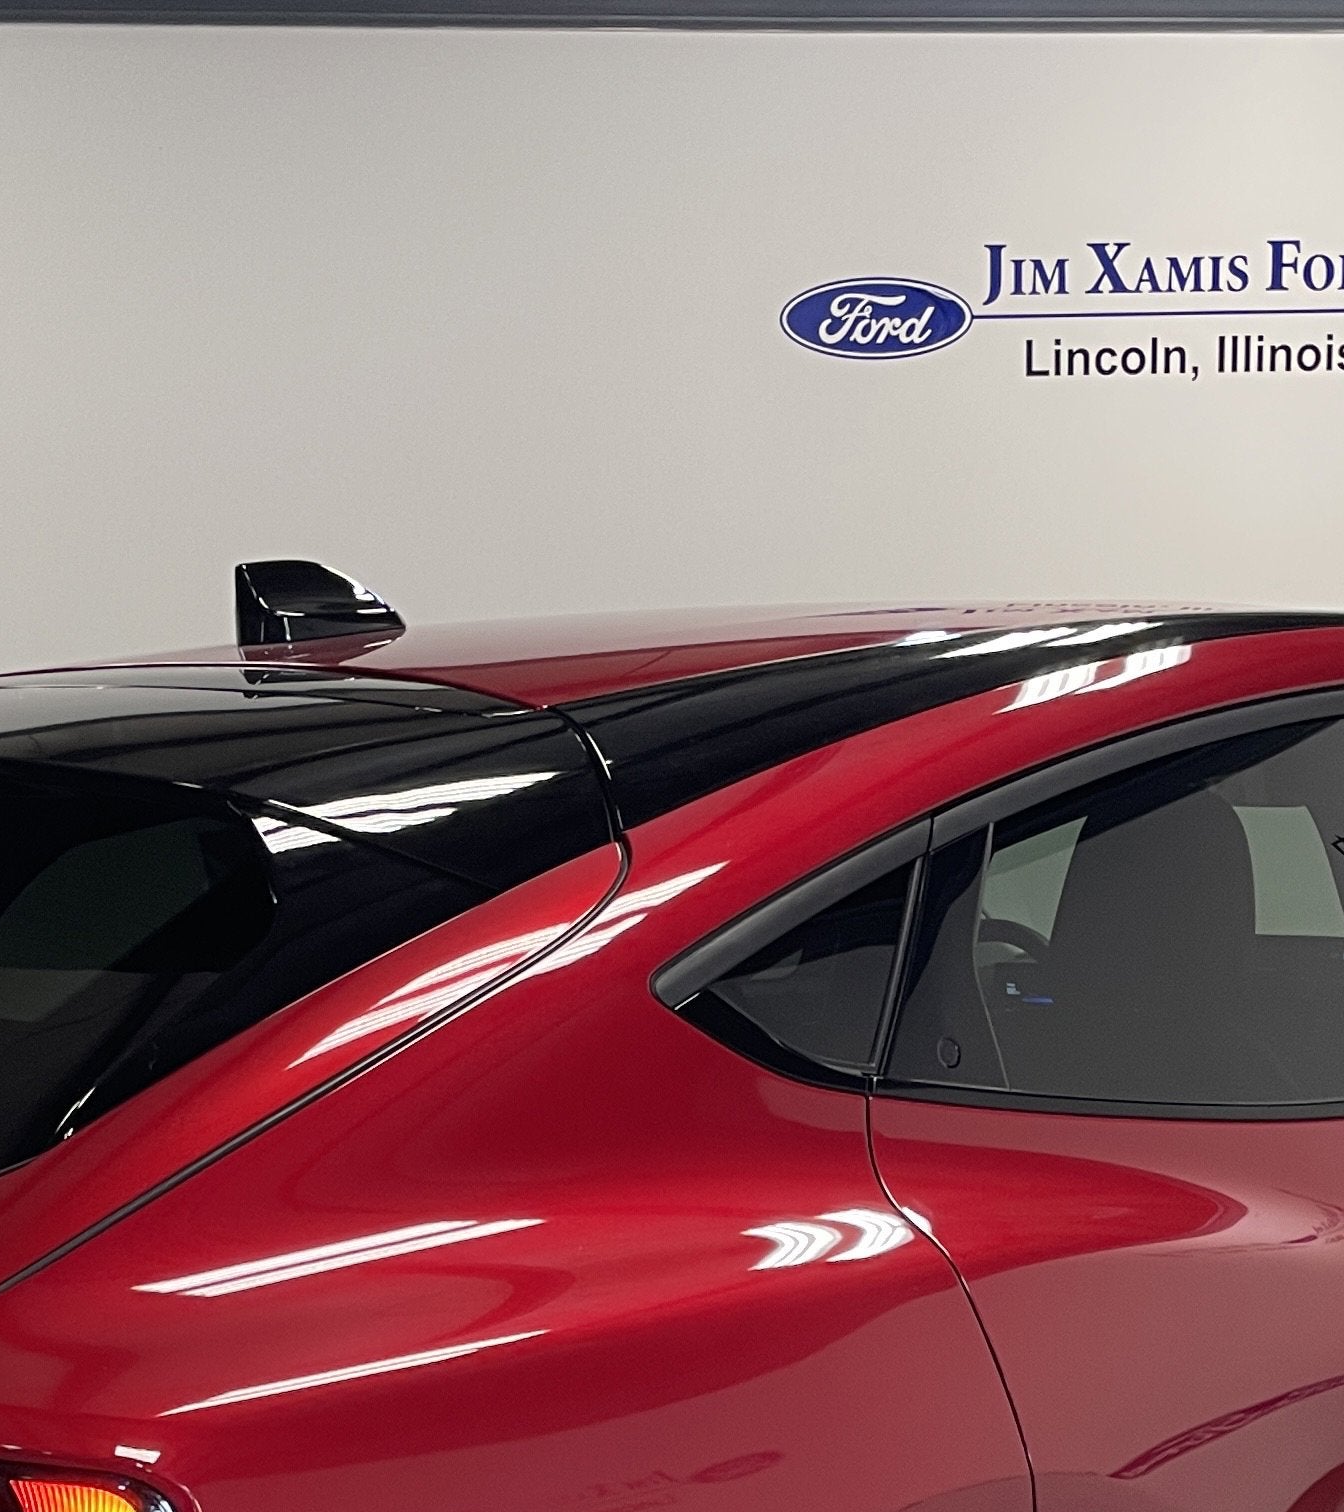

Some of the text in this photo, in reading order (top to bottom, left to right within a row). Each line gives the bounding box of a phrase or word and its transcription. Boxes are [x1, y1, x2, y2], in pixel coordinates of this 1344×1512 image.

[983, 244, 1069, 306] JIM
[1085, 242, 1249, 294] XAMIS
[817, 292, 935, 349] Ford
[1026, 336, 1199, 382] Lincoln,
